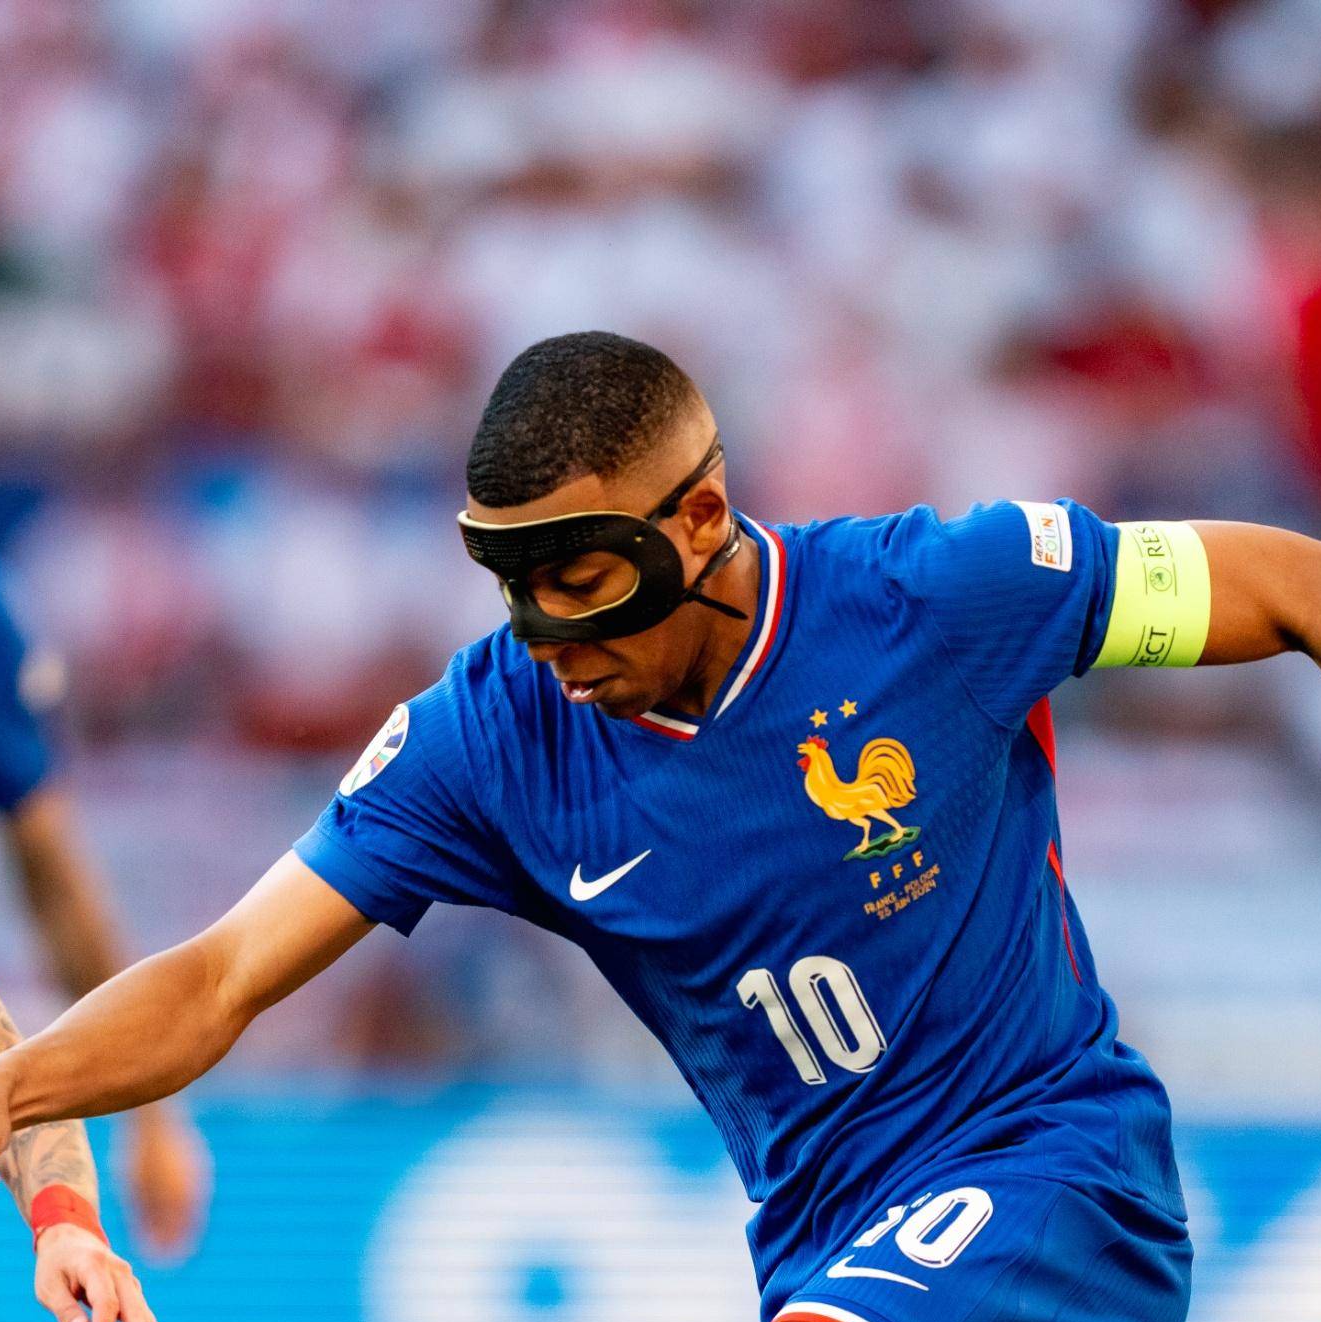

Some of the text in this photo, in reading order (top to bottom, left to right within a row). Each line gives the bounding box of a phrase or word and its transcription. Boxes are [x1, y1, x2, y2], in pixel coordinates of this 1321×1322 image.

[1134, 625, 1167, 667] ECT
[736, 955, 888, 1085] 10
[852, 1186, 994, 1269] 10
